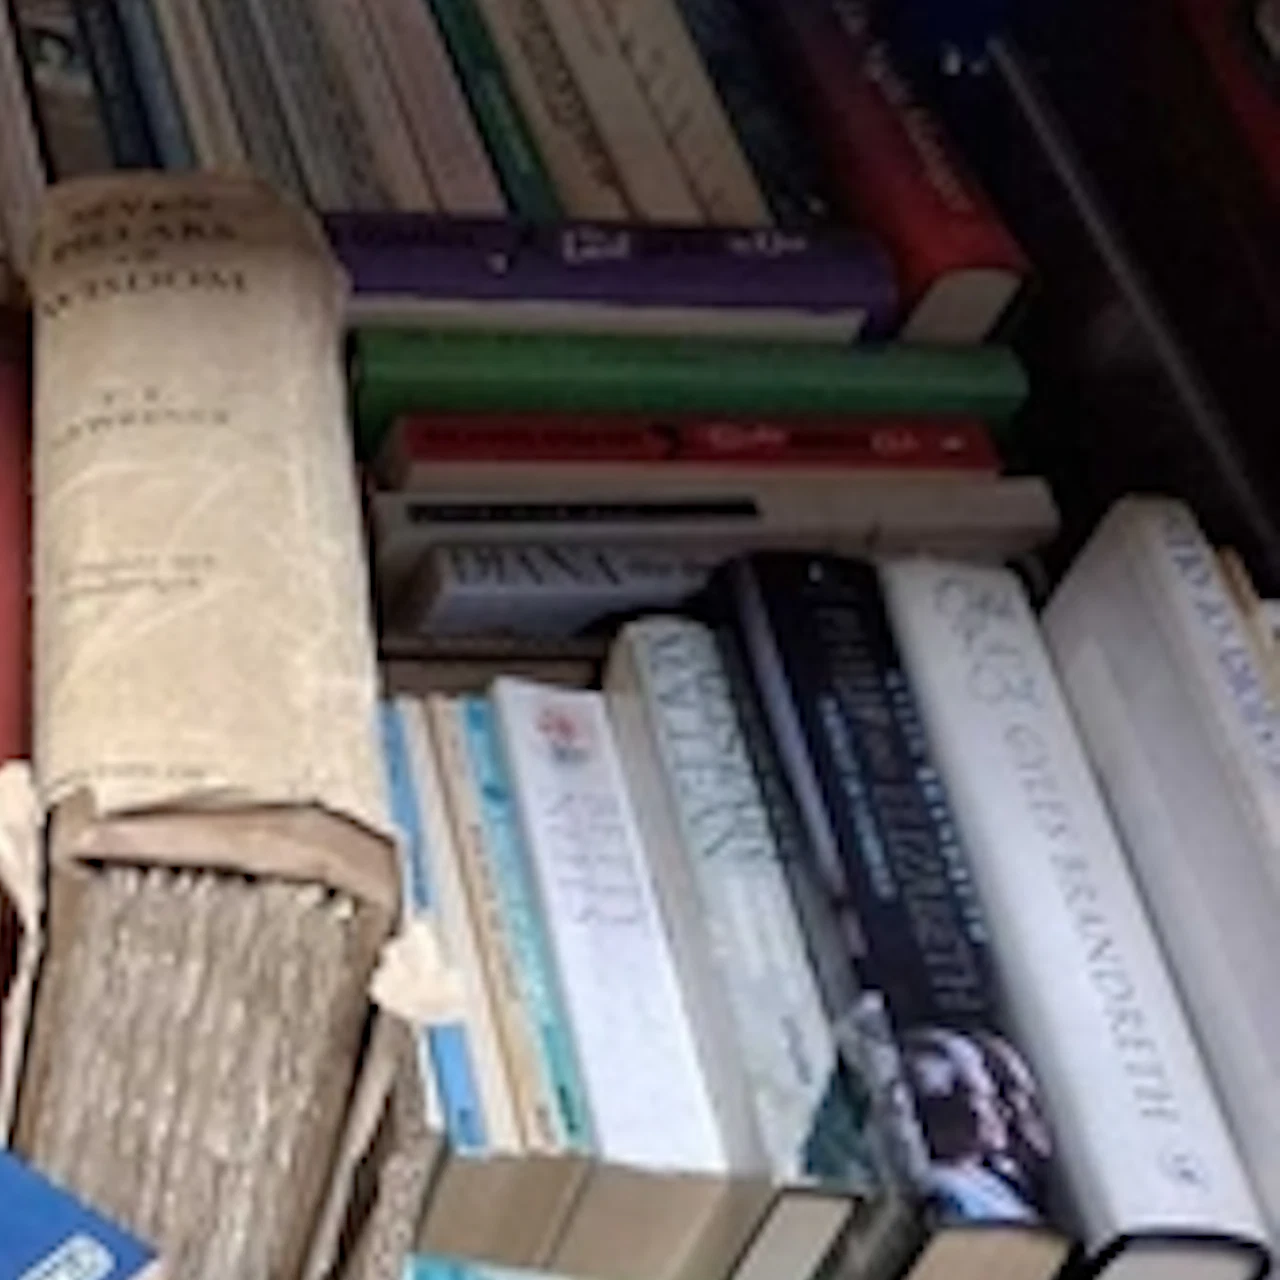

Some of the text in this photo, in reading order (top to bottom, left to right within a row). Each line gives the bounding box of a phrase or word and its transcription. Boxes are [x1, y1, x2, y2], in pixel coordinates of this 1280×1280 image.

[40, 264, 249, 320] WISDOM
[452, 546, 626, 589] DIANA
[1052, 854, 1182, 1121] BRANDRETH
